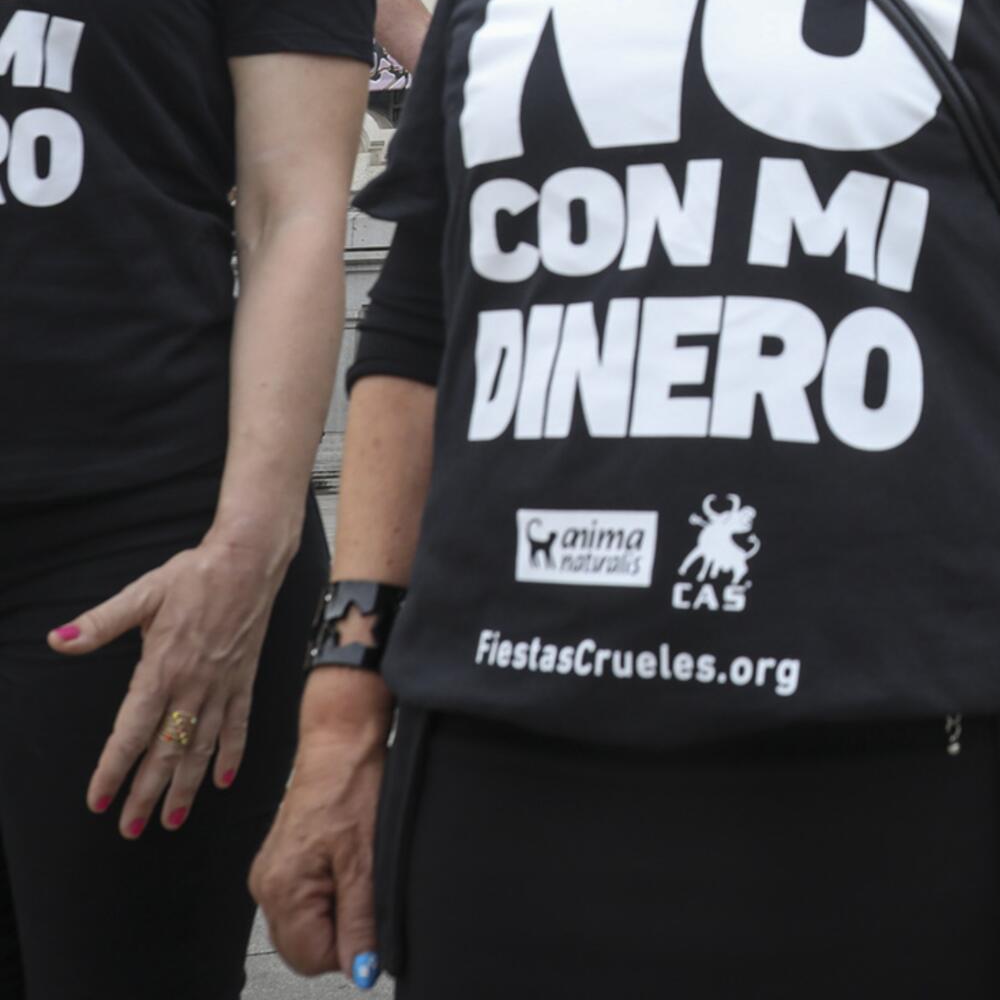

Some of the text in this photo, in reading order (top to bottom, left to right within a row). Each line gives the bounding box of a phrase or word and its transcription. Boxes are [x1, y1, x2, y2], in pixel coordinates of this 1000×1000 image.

[470, 157, 930, 292] CON MI
[467, 296, 924, 452] DINERO
[559, 519, 645, 551] anima
[671, 582, 747, 612] CAS
[474, 629, 801, 697] FiestasCrueles.org
